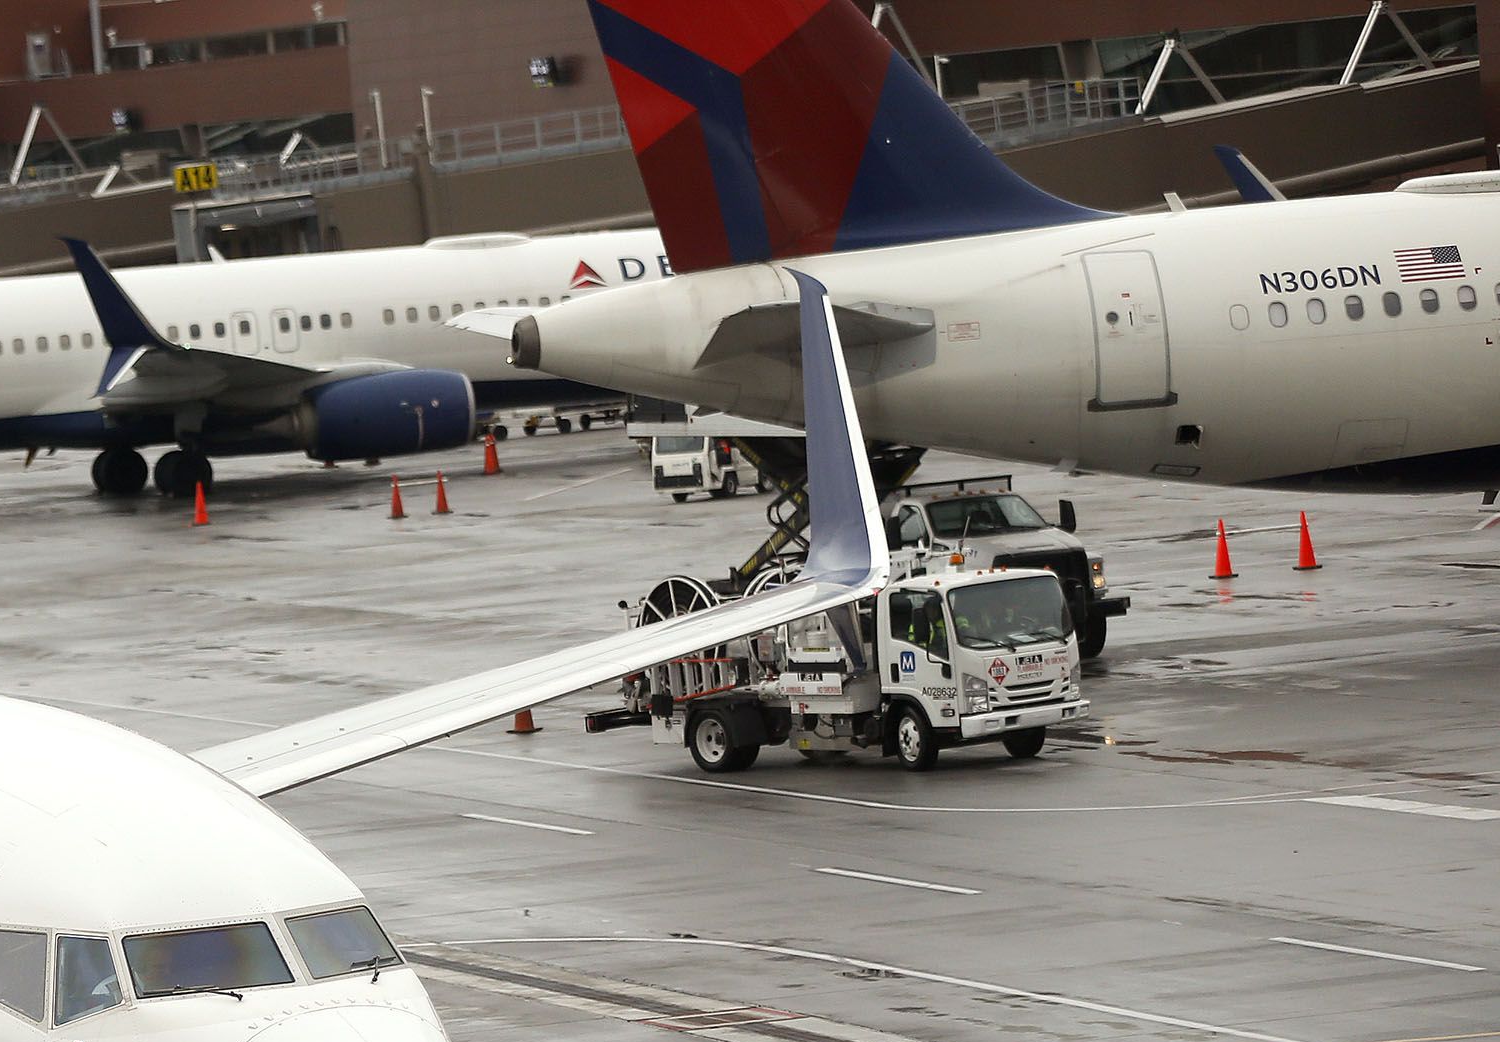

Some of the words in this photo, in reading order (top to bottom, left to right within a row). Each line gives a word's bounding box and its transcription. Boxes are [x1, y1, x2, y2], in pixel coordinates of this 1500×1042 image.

[180, 167, 213, 190] A14
[1259, 265, 1381, 294] N306DN
[922, 687, 958, 696] A028632
